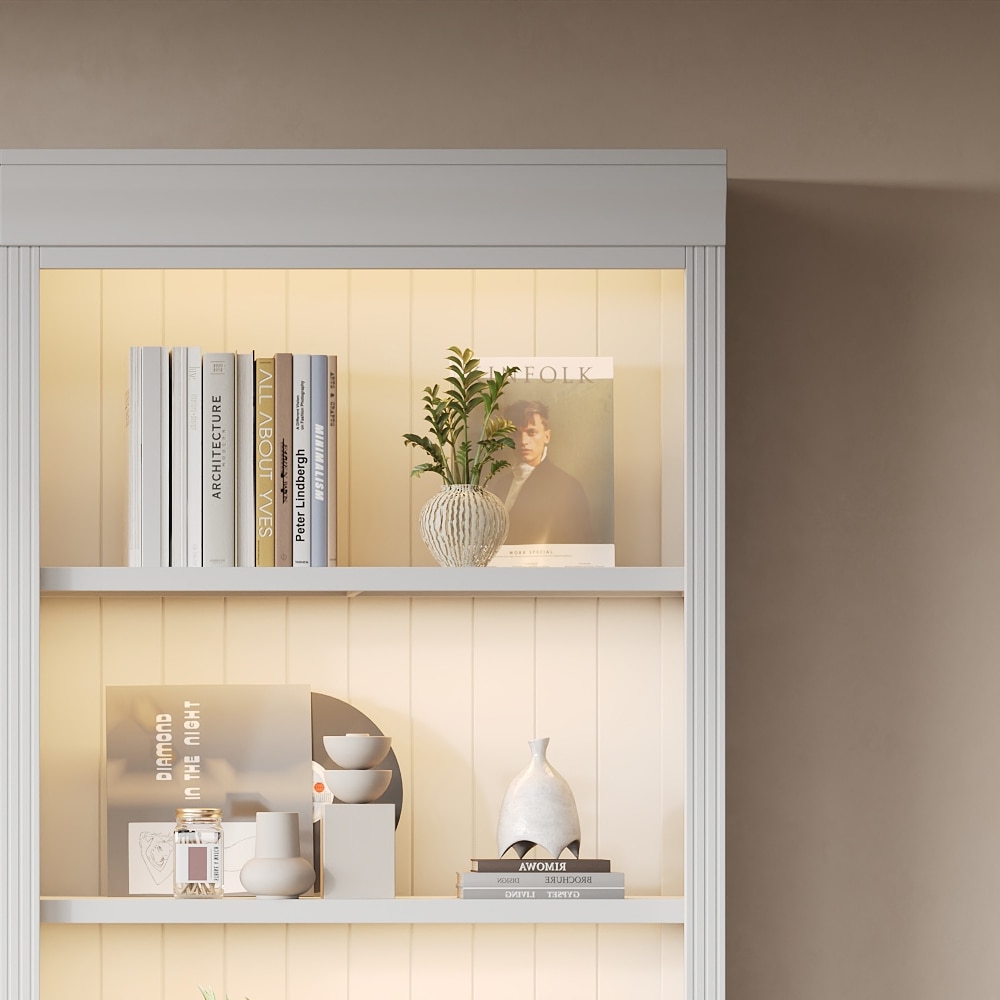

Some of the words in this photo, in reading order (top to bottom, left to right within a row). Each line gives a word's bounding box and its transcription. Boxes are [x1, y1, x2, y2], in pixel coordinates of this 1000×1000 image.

[258, 368, 273, 405] ALL
[475, 365, 594, 384] INFOLK
[212, 395, 222, 500] ARCHITECTURE
[258, 411, 273, 481] ABOUT
[314, 424, 324, 502] MINIMALISM
[296, 448, 308, 509] Lindbergh
[258, 489, 273, 538] YVES
[296, 511, 306, 542] Peter
[156, 713, 172, 781] DIAMOND
[184, 700, 201, 746] NIGHT
[184, 754, 201, 781] THE
